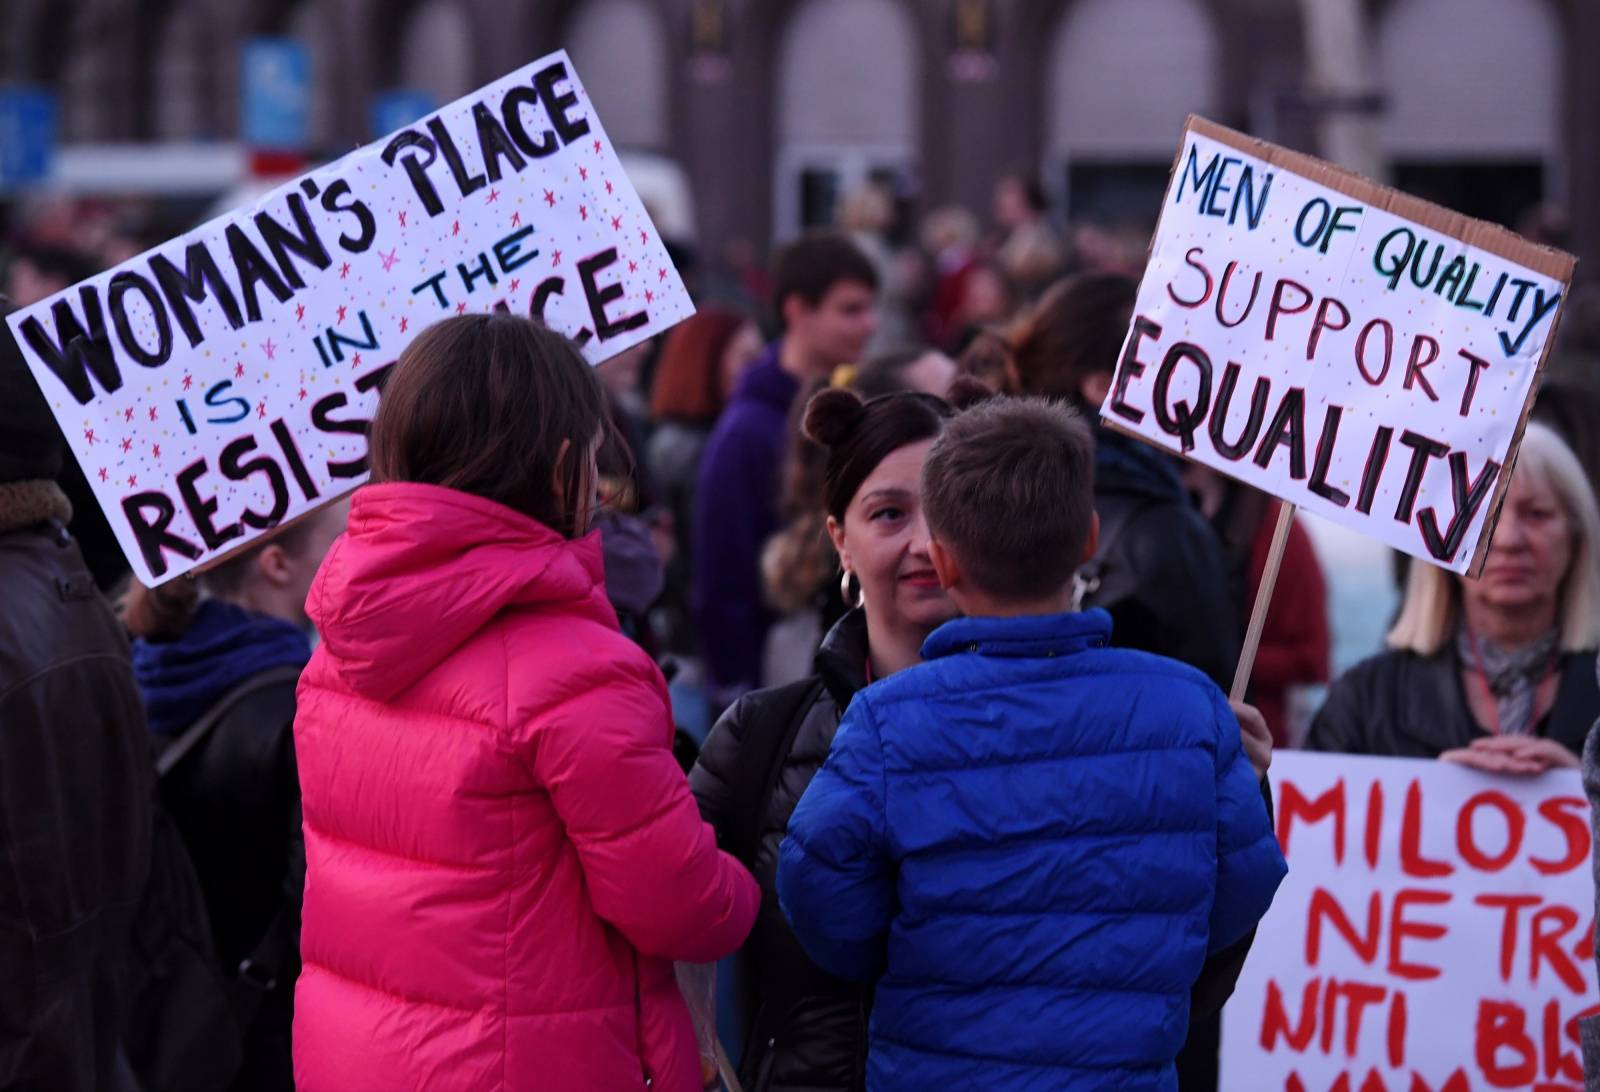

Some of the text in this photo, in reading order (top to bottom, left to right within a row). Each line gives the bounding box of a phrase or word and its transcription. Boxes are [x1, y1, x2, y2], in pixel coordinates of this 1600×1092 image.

[18, 62, 591, 406] WOMAN'S PLACE
[176, 224, 540, 435] IS IN THE
[1166, 246, 1490, 417] SUPPORT
[1175, 142, 1563, 358] MEN OF QUALITY
[1110, 315, 1501, 564] EQUALITY
[1258, 975, 1408, 1069] NITI
[1304, 885, 1453, 981] NE
